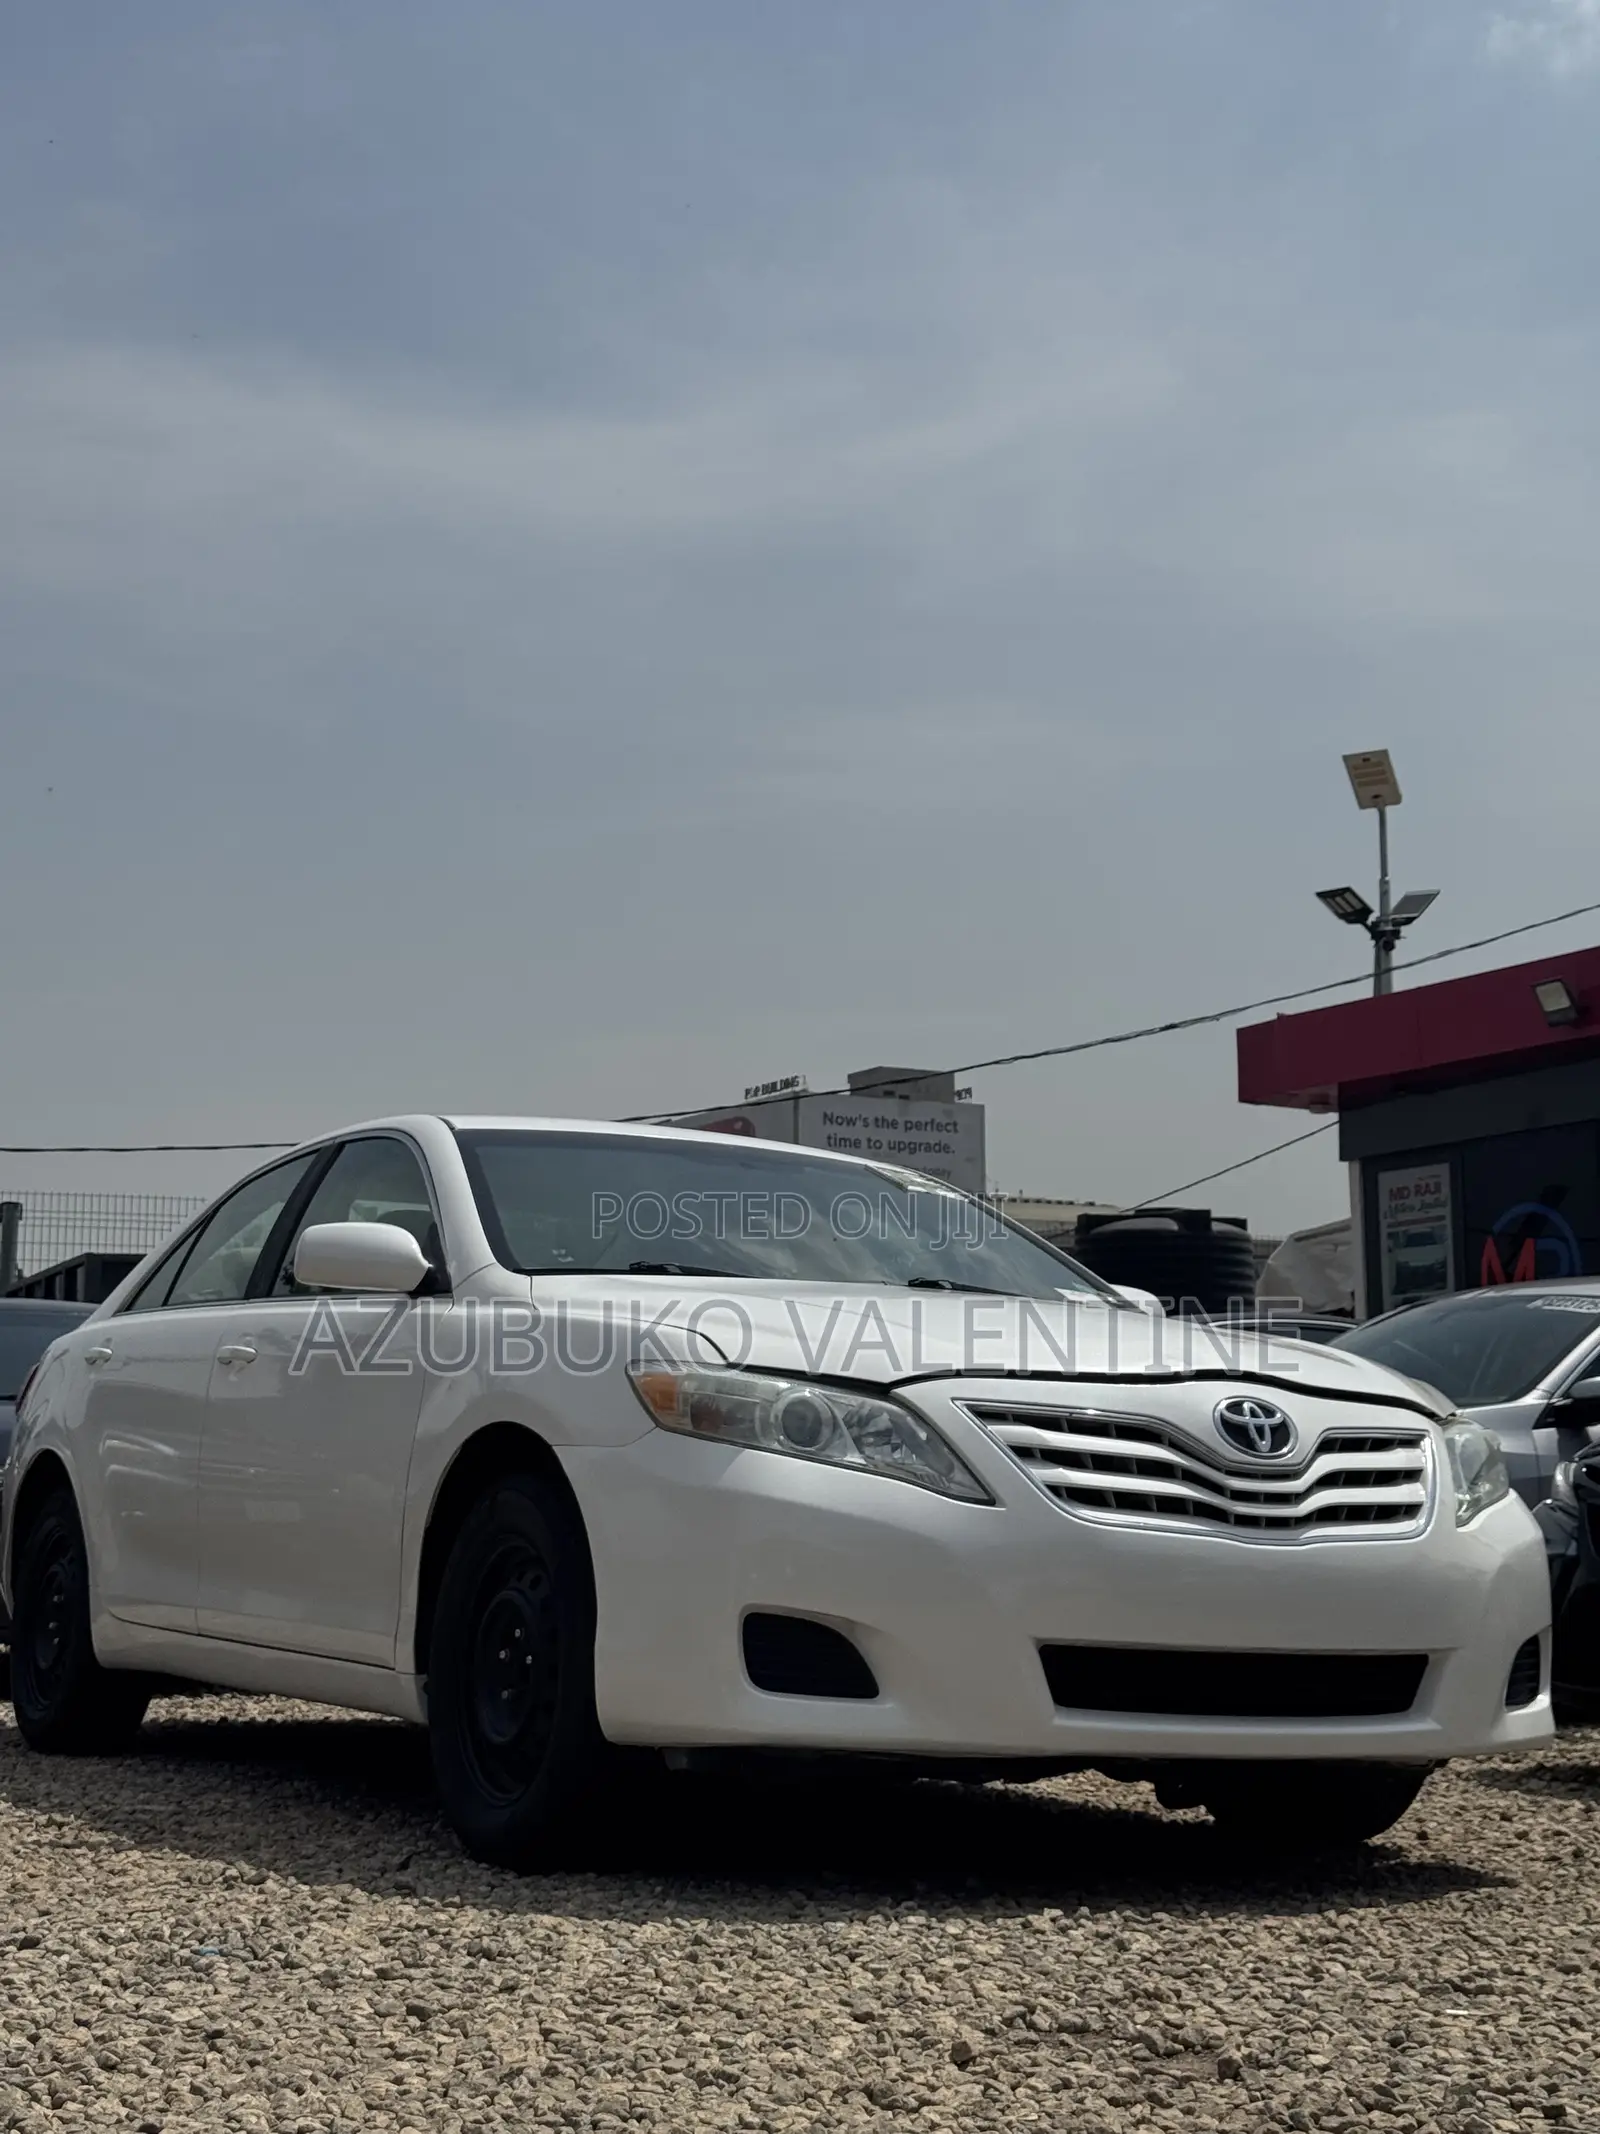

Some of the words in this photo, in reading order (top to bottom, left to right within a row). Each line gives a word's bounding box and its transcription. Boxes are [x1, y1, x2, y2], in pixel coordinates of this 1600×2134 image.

[822, 1111, 869, 1129] Now's
[874, 1114, 898, 1130] the
[904, 1117, 959, 1135] perfect
[826, 1132, 861, 1149] time
[867, 1135, 884, 1150] to
[888, 1137, 955, 1155] upgrade.
